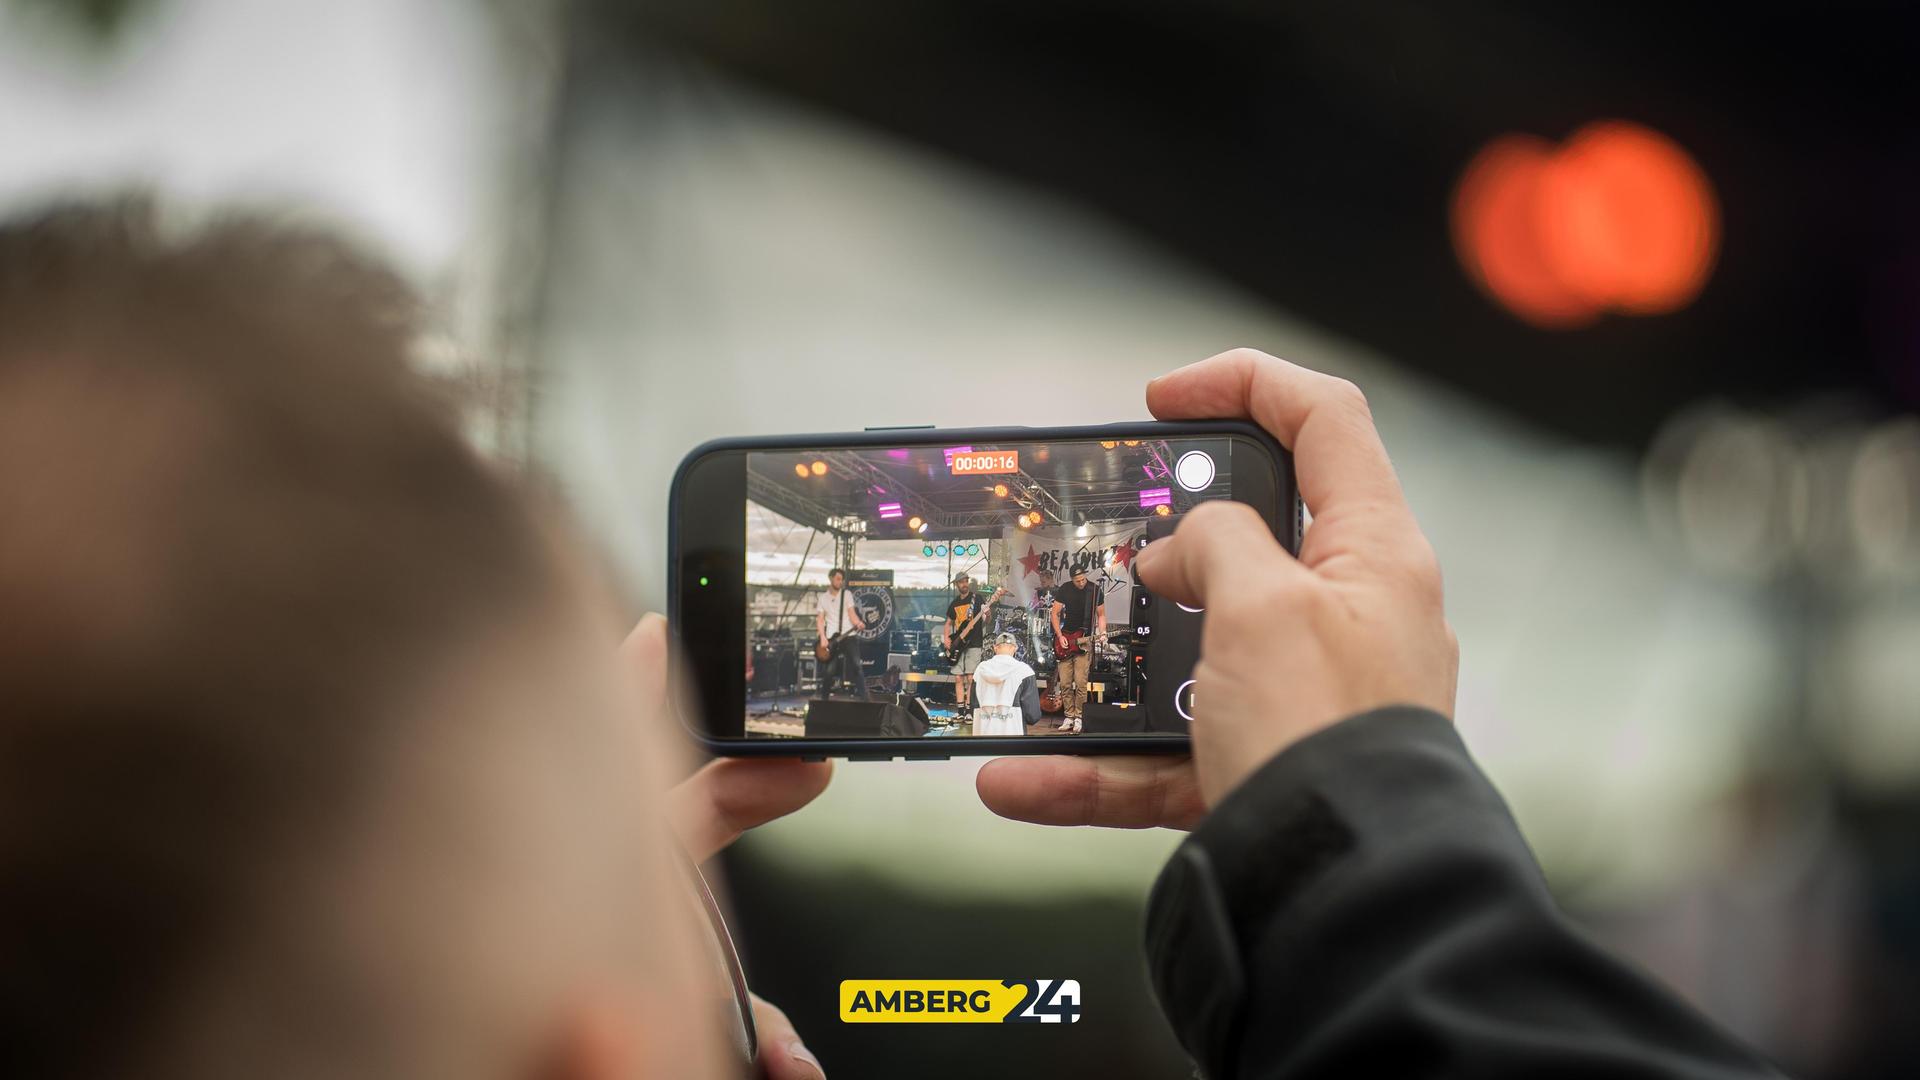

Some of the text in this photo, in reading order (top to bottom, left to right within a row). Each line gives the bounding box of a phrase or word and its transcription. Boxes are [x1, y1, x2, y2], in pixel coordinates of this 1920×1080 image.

[955, 456, 1014, 470] 00:00:16
[1140, 539, 1147, 547] 5
[1039, 546, 1118, 571] BEATNIK
[1141, 597, 1146, 605] 1
[1137, 626, 1150, 635] 0,5
